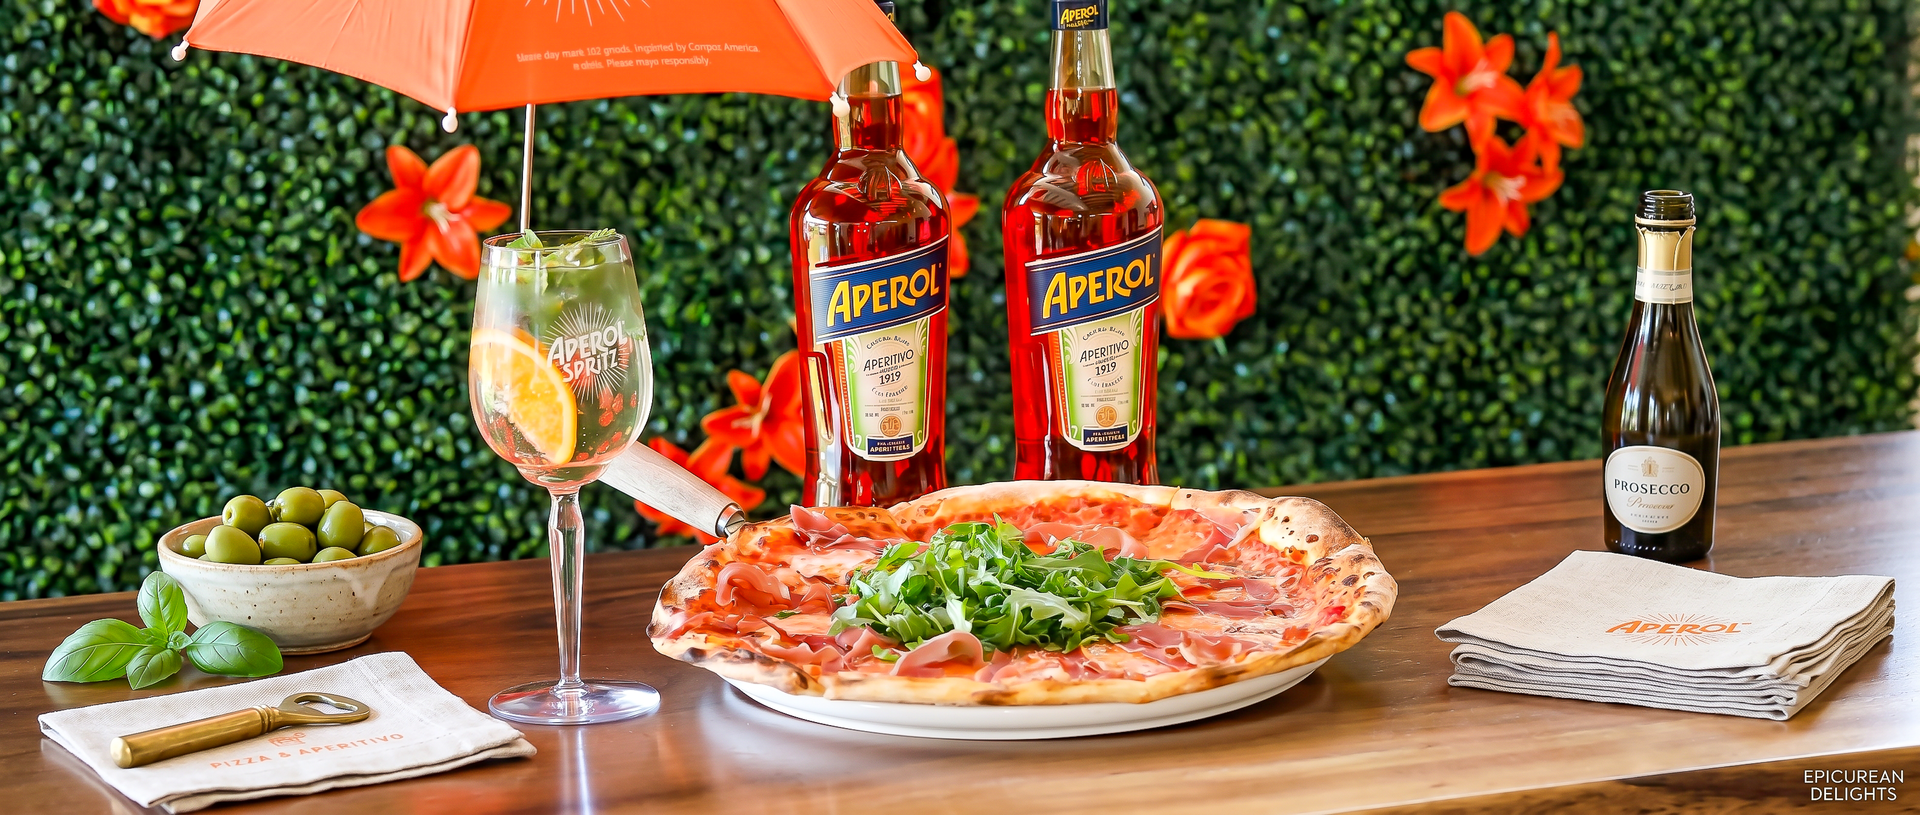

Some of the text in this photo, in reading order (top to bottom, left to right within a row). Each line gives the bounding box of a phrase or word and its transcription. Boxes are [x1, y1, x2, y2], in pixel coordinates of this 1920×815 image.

[1060, 4, 1099, 25] APEROL
[675, 43, 687, 53] by
[724, 42, 761, 53] America.
[606, 58, 634, 68] Please
[661, 55, 712, 67] responsibly.
[826, 263, 940, 328] APEROL
[1042, 253, 1154, 319] APEROL
[547, 320, 628, 368] APEROL
[1079, 339, 1130, 363] APERITIVO
[863, 348, 915, 372] APERITIVO
[1094, 361, 1117, 376] 1919
[878, 370, 902, 385] 1919
[1614, 478, 1690, 495] PROSECCO
[1605, 620, 1742, 635] APEROL
[209, 755, 272, 769] PIZZA
[298, 732, 405, 756] APERITIVO
